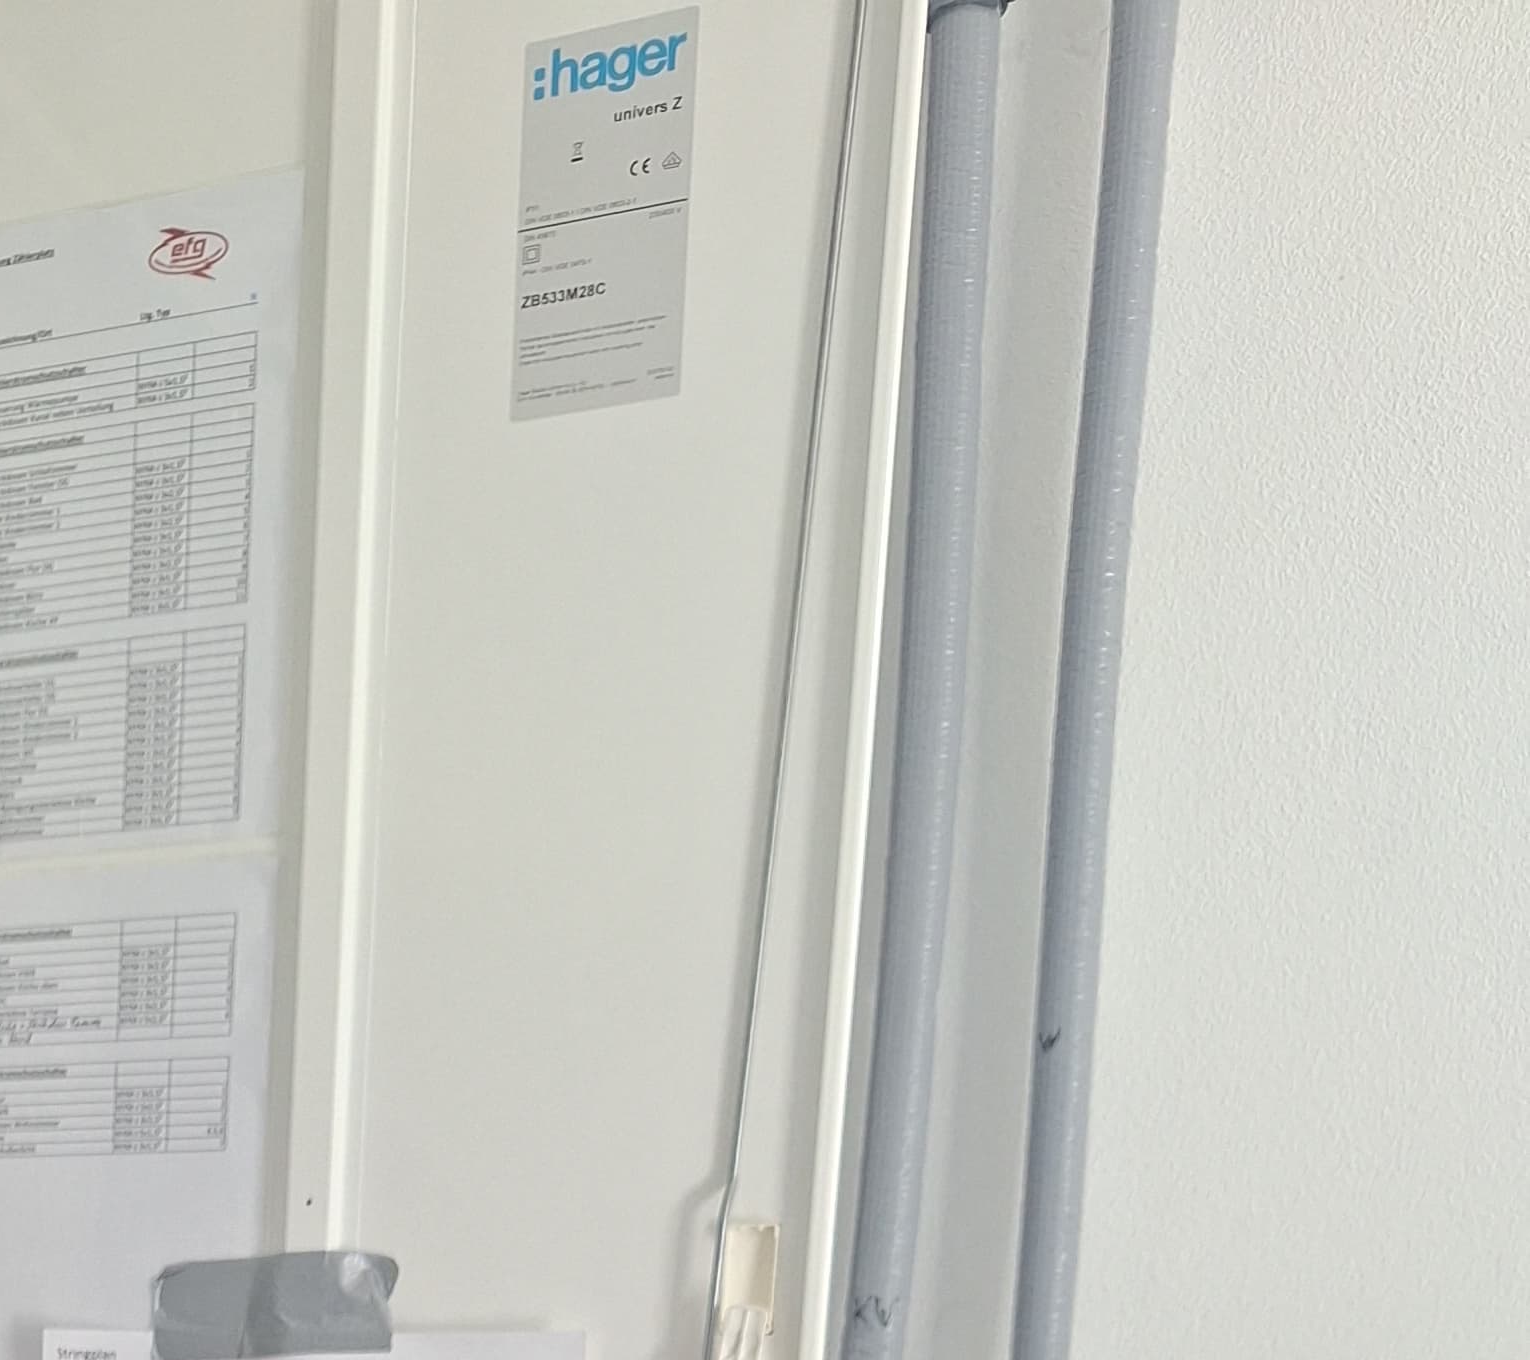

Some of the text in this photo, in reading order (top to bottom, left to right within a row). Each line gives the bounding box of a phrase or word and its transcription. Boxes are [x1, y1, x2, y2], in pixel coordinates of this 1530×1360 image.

[613, 96, 683, 122] univers Z
[171, 237, 207, 263] efg
[520, 282, 607, 309] ZB533M28C
